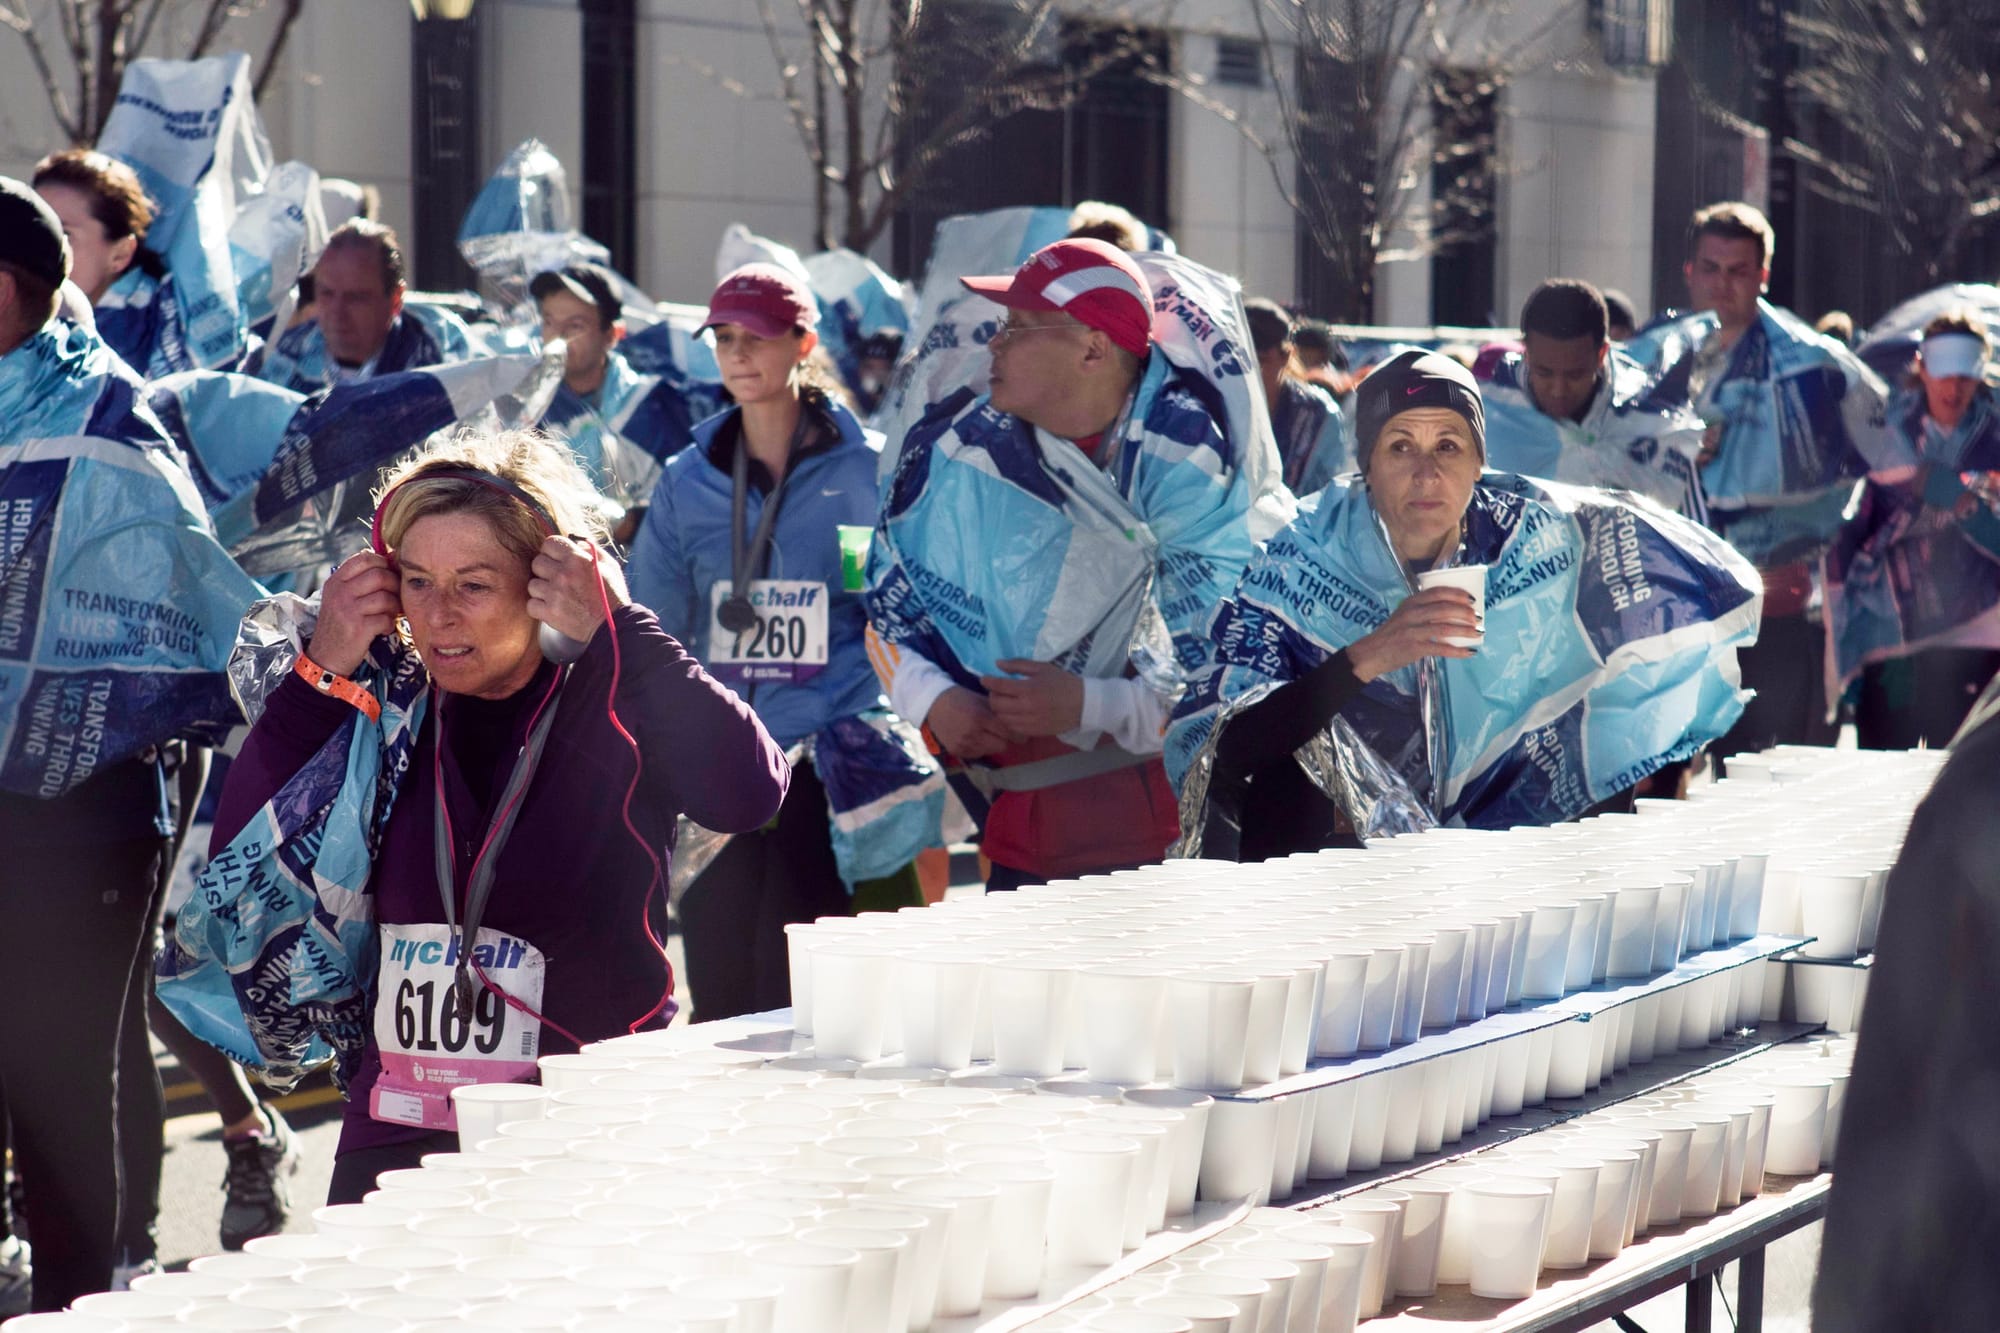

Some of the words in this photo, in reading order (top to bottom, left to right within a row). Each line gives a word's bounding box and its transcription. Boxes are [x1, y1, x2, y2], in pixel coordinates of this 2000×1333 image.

[1599, 517, 1631, 612] THROUGH
[0, 557, 33, 651] RUNNING
[721, 585, 823, 607] chalf
[1250, 570, 1315, 617] UNNING
[1297, 568, 1384, 630] THROUGH
[54, 638, 146, 659] RUNNING
[58, 613, 118, 639] LIVES
[25, 678, 65, 757] UNNING
[58, 678, 89, 726] IVES
[394, 977, 506, 1055] 6169
